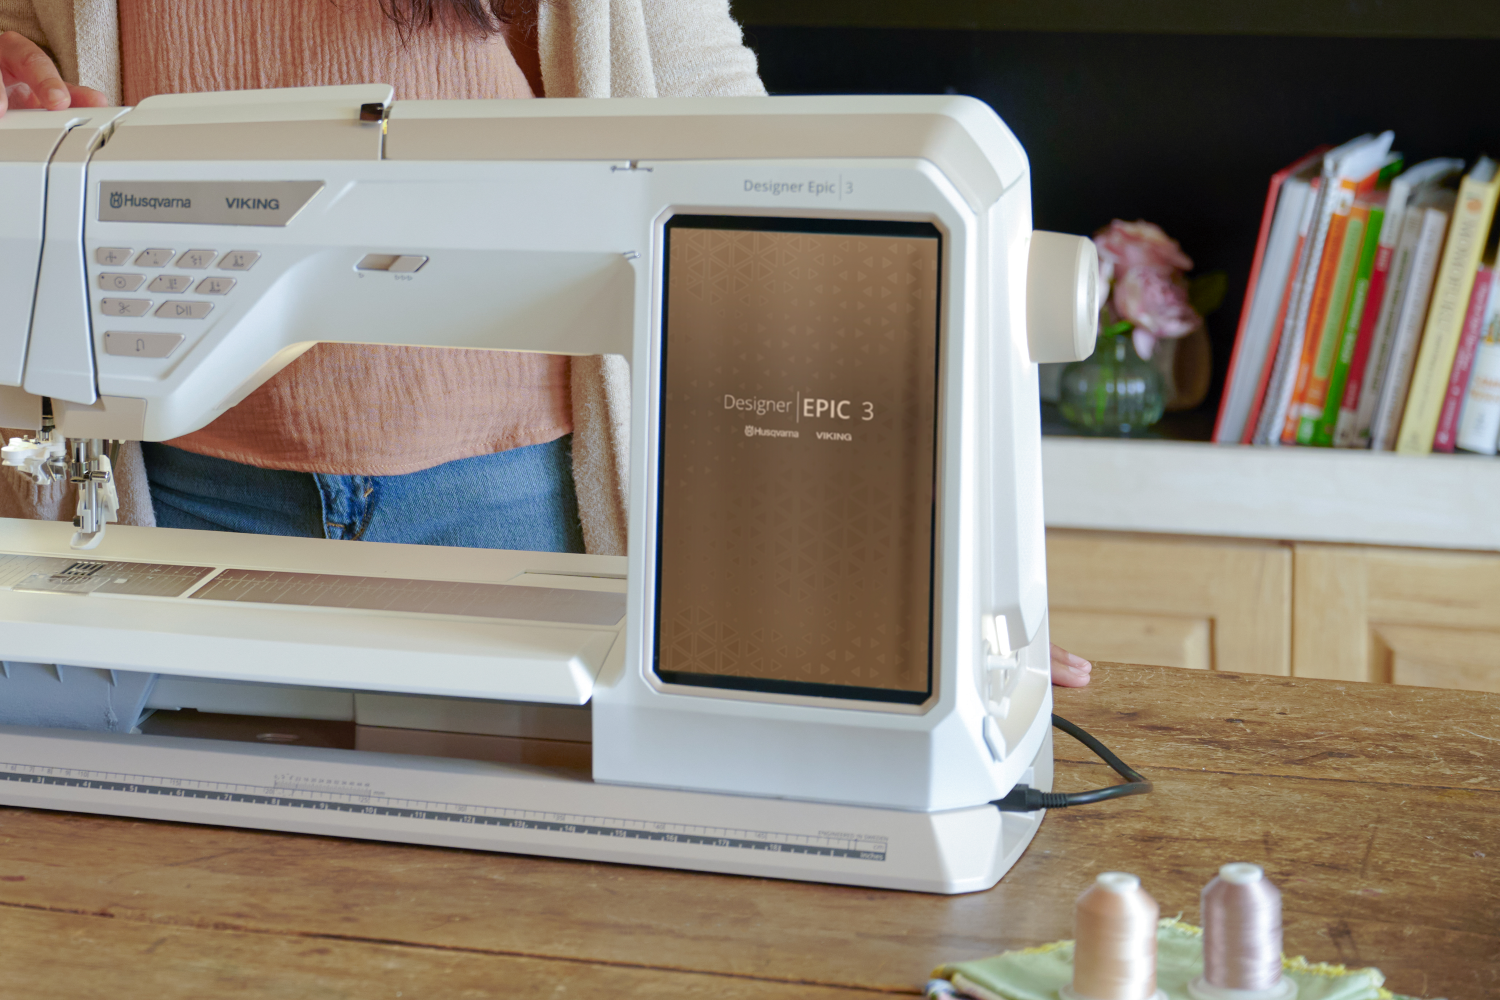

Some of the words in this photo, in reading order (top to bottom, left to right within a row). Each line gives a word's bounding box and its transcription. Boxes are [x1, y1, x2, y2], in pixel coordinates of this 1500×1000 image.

[743, 179, 804, 196] Designer
[808, 181, 836, 197] Epic
[845, 181, 854, 195] 3
[124, 194, 191, 210] Husqvarna
[225, 197, 280, 210] VIKING
[724, 394, 793, 415] Designer
[803, 398, 851, 419] EPIC
[861, 401, 874, 421] 3
[754, 426, 799, 439] Husqvarna
[816, 431, 852, 442] VIKING
